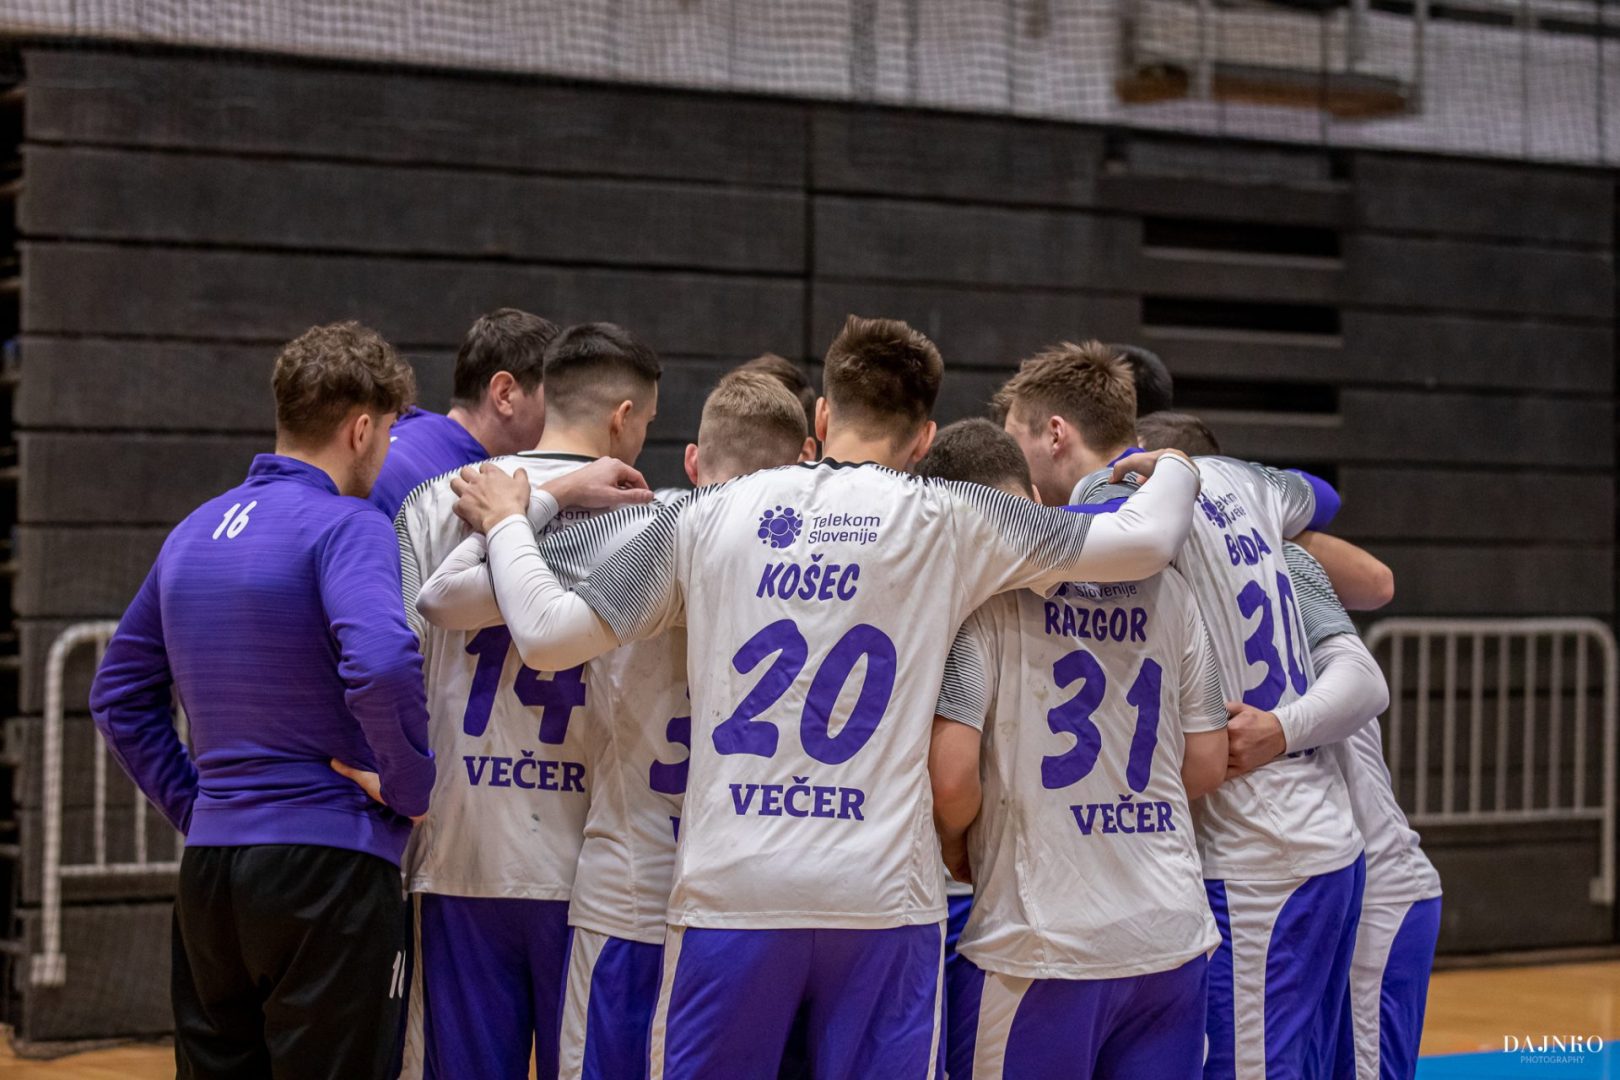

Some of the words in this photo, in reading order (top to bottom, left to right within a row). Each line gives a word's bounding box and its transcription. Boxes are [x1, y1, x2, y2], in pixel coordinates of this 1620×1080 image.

[211, 500, 258, 540] 16
[808, 528, 878, 545] Slovenije
[812, 513, 881, 528] Telekom
[756, 553, 860, 601] KOŠEC
[1074, 583, 1138, 598] Slovenije
[1044, 601, 1148, 643] RAZGOR
[1236, 570, 1308, 712] 30
[463, 625, 587, 745] 14
[711, 618, 897, 765] 20
[1041, 649, 1163, 793] 31
[463, 750, 586, 793] VEČER
[729, 776, 866, 821] VEČER
[1070, 794, 1176, 835] VEČER
